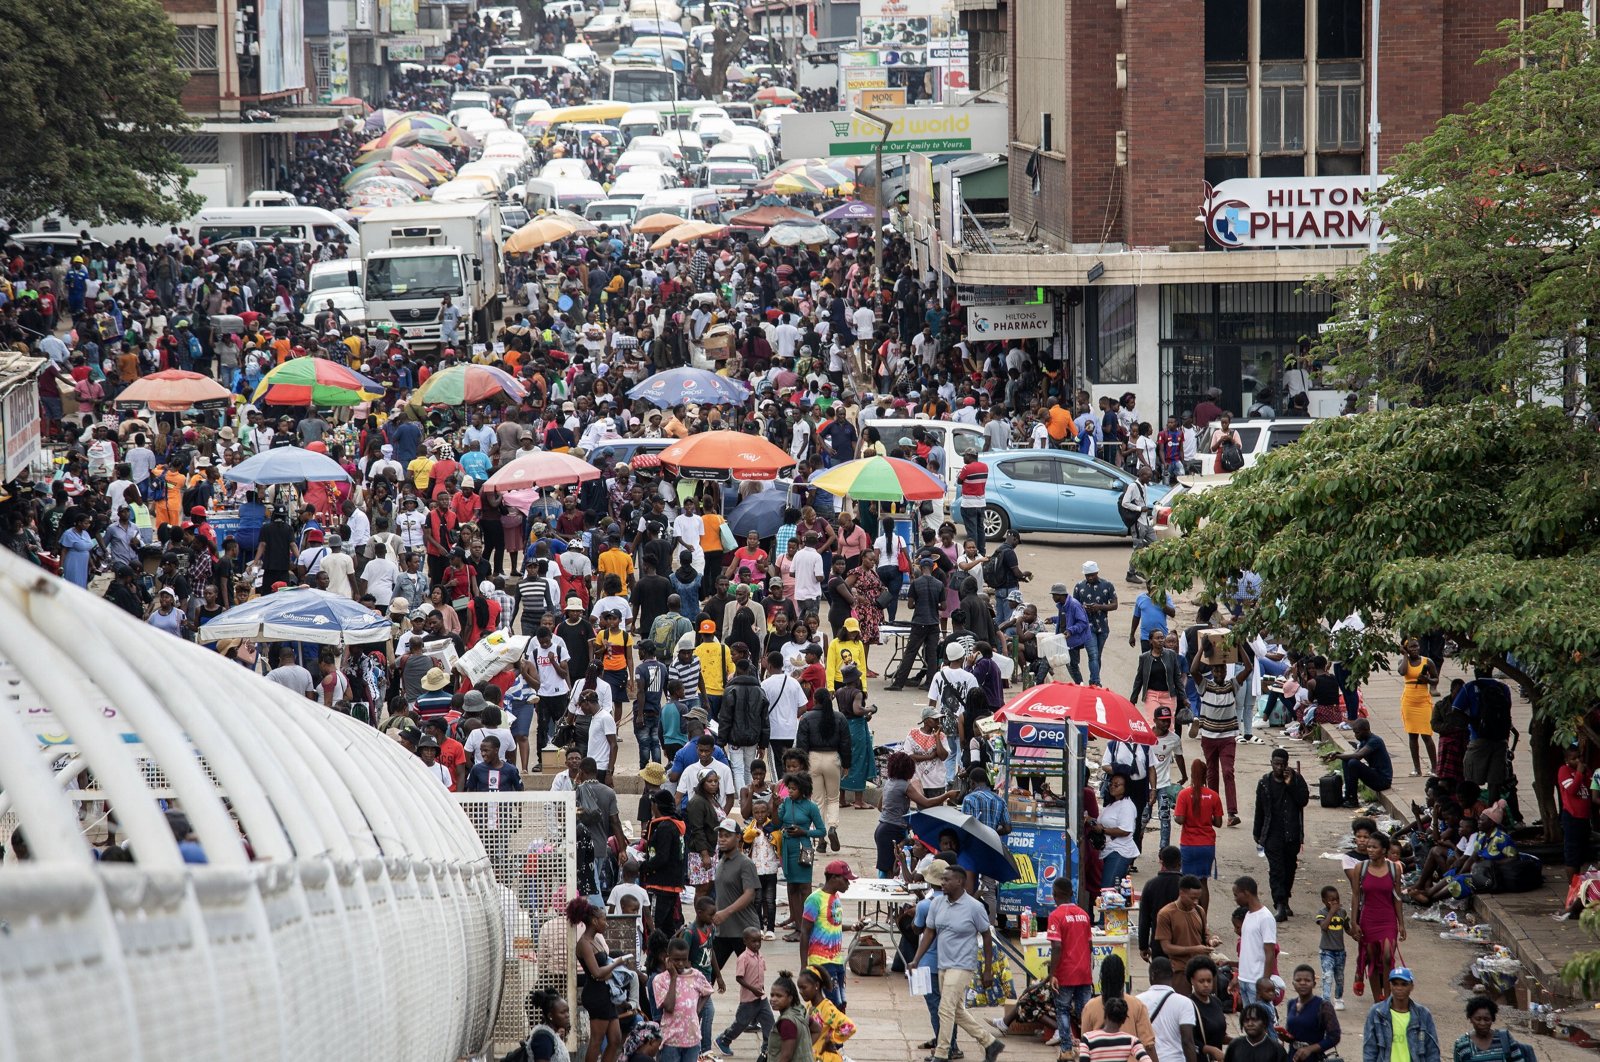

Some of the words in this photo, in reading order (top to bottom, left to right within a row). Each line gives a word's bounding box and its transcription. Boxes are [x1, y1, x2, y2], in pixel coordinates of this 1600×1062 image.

[871, 93, 893, 102] MORE
[852, 116, 905, 137] fod
[909, 113, 970, 134] world
[906, 142, 931, 153] Family
[942, 141, 965, 149] Yours.
[1005, 312, 1037, 320] HILTONS
[993, 320, 1048, 331] PHARMACY
[1028, 702, 1071, 715] Coca-Cola
[1039, 730, 1065, 742] pep
[1007, 837, 1035, 848] PRIDE
